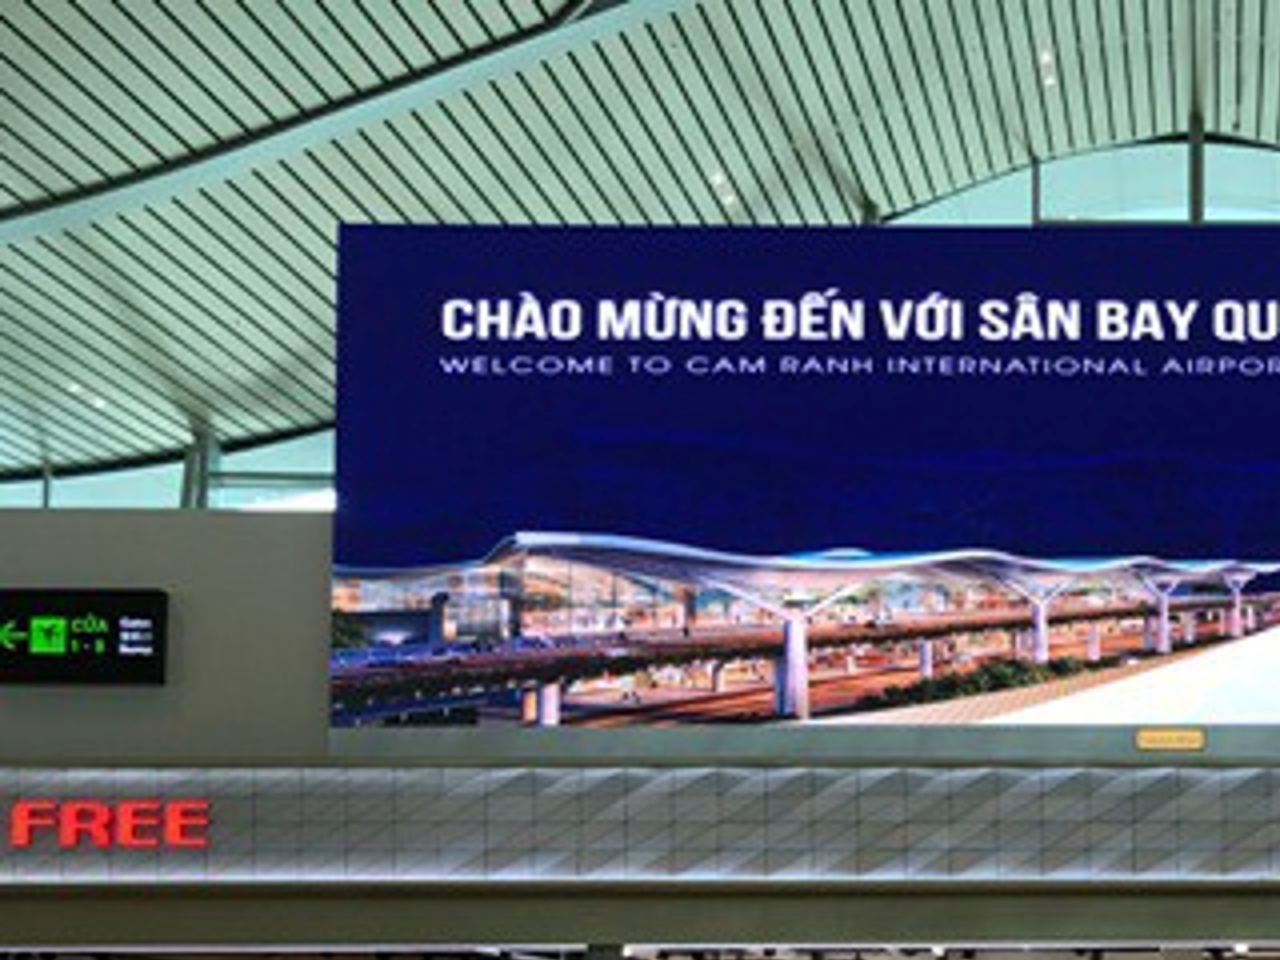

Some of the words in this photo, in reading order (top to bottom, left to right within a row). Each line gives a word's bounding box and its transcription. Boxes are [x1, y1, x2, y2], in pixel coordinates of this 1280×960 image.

[441, 291, 582, 341] CHÀO
[597, 291, 748, 341] MỪNG
[760, 287, 866, 341] ĐẾN
[879, 291, 964, 341] VỚI
[978, 291, 1081, 341] SÂN
[1097, 299, 1199, 341] BAY
[439, 356, 612, 374] WELCOME
[630, 356, 672, 374] TO
[686, 356, 767, 374] CAM
[780, 356, 874, 374] RANH
[887, 356, 1146, 376] INTERNATIONAL
[9, 799, 210, 848] FREE
